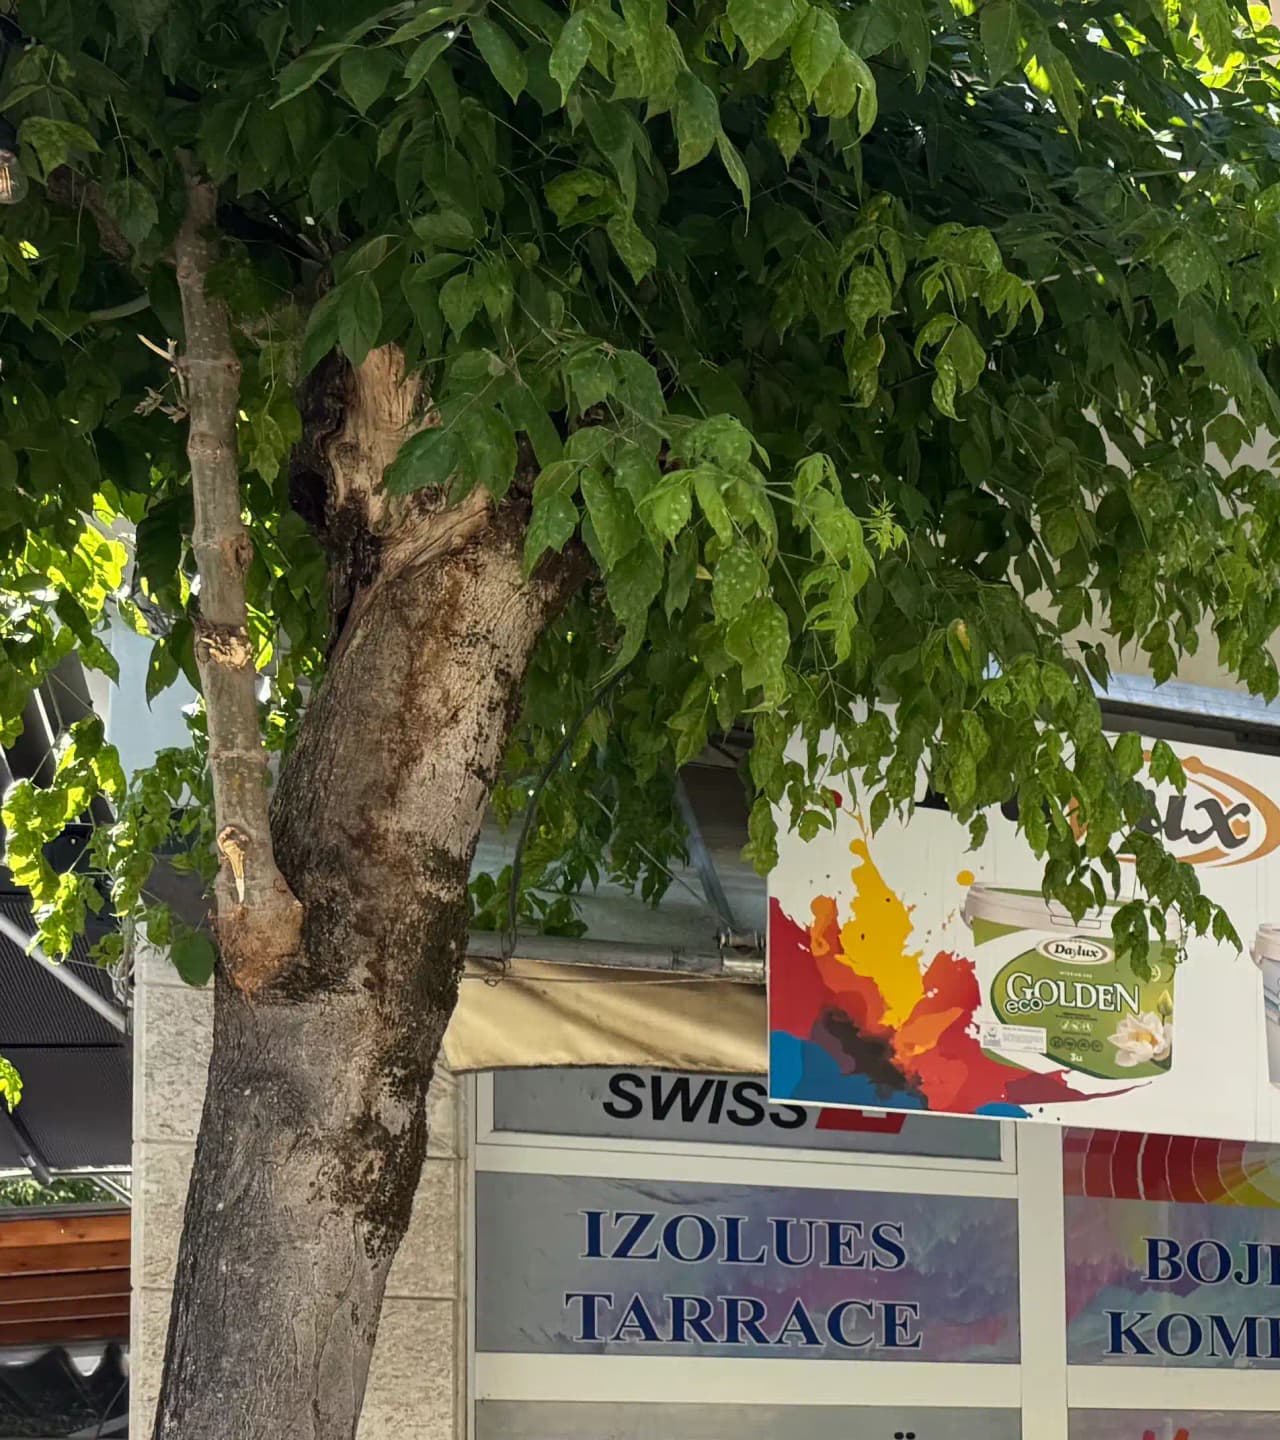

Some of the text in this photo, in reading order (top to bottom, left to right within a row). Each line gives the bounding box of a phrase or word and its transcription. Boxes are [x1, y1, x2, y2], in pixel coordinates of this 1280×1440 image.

[1005, 996, 1045, 1015] eco
[1006, 971, 1140, 1015] GOLDEN
[602, 1073, 808, 1129] SWISS
[579, 1209, 908, 1271] IZOLUES
[564, 1291, 923, 1350] TARRACE
